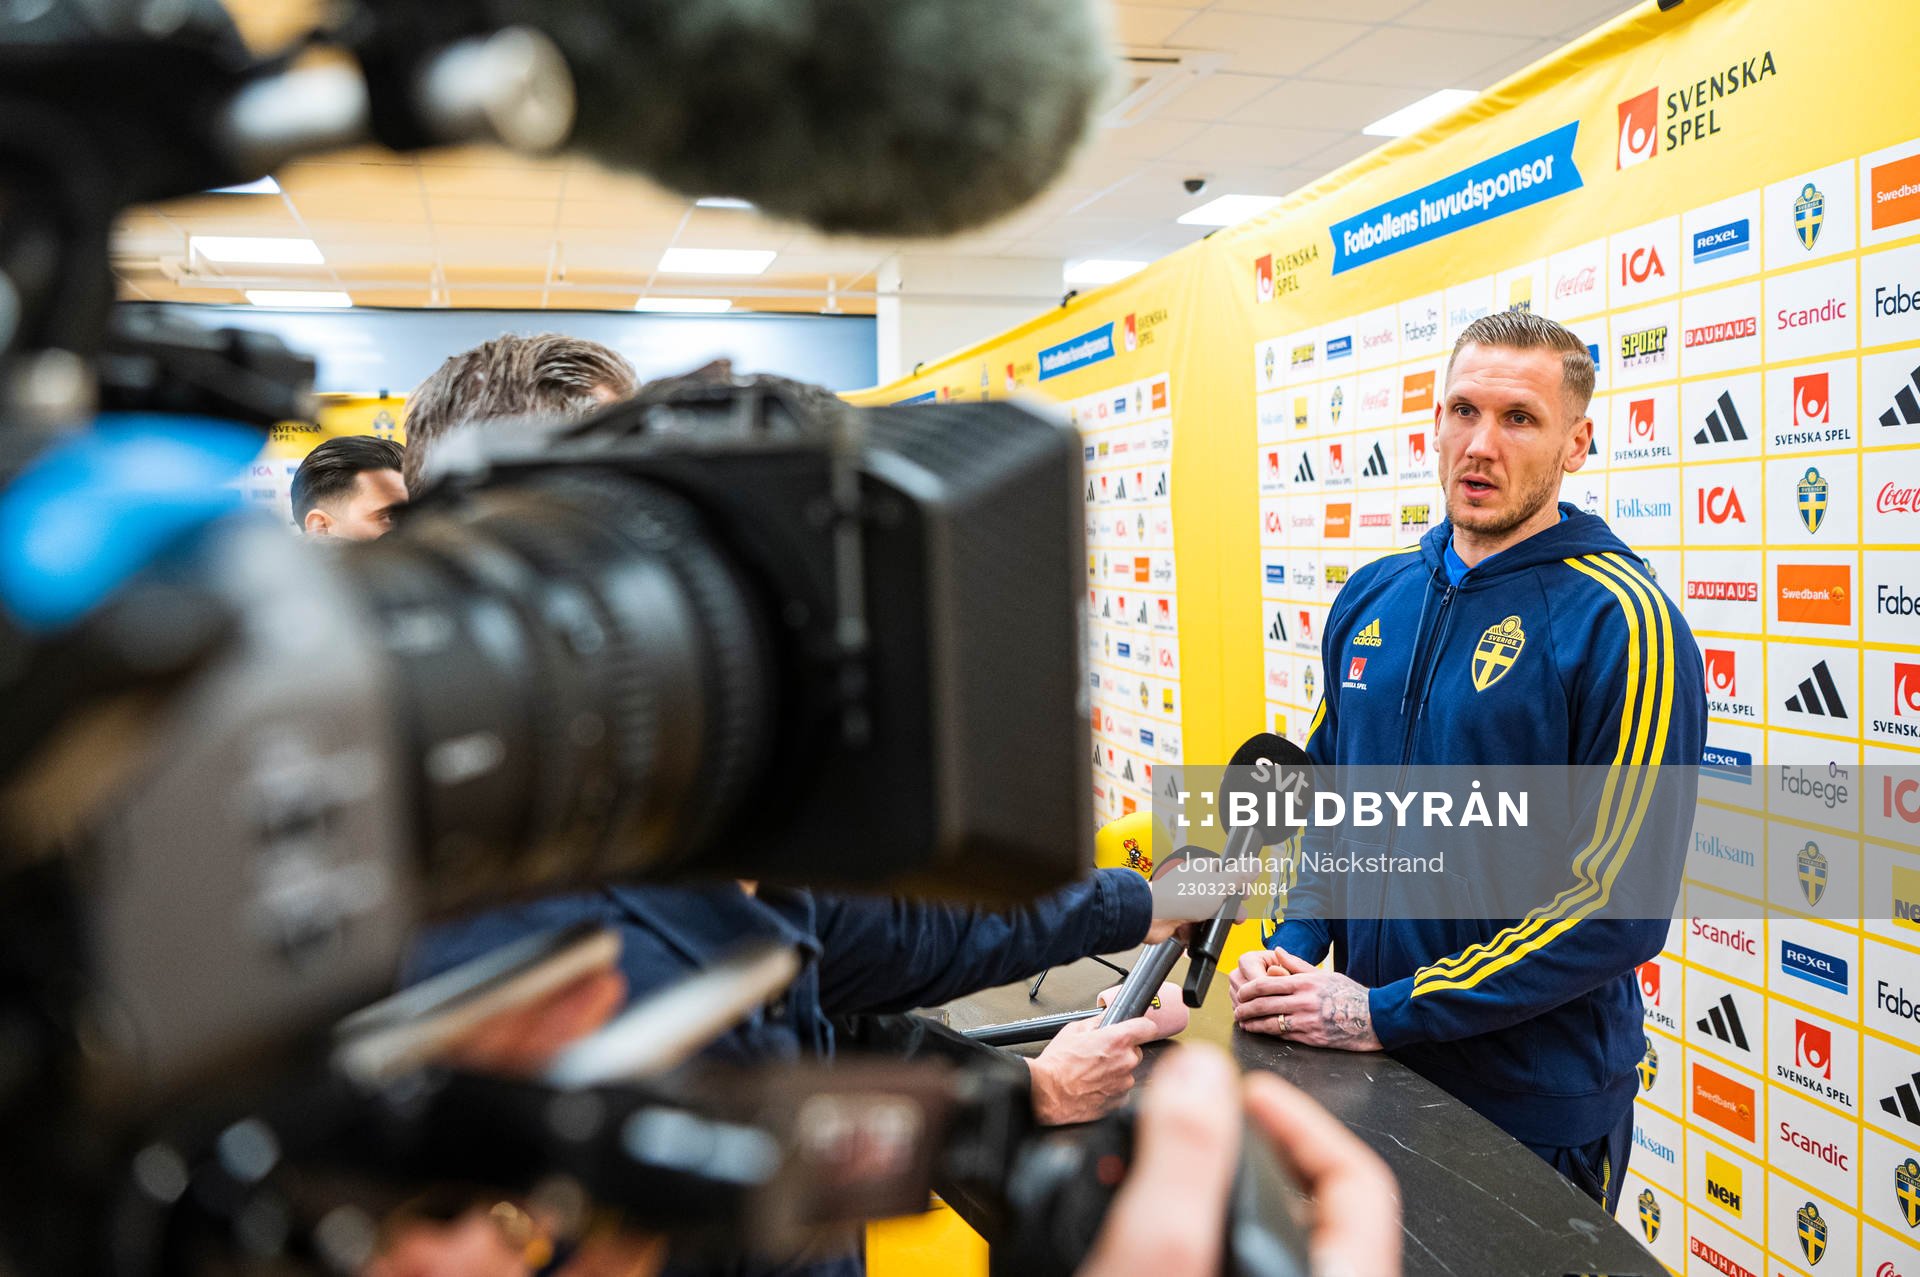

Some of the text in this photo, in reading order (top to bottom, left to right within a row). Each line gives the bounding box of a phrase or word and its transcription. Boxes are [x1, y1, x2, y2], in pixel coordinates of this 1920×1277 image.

[1667, 51, 1777, 120] SVENSKA
[1667, 109, 1721, 151] SPEL
[1344, 154, 1554, 256] Fotbollens huvudsponsor
[1622, 245, 1665, 287] ICA
[1777, 298, 1847, 330] Scandic
[1876, 284, 1920, 317] Fabe
[1405, 322, 1437, 342] Fabege
[1621, 325, 1667, 359] SPORT
[1686, 317, 1756, 347] BAUHAUS
[1623, 353, 1666, 368] BLADET
[272, 424, 321, 435] SVENSKA
[1775, 429, 1851, 446] SVENSKA SPEL
[1615, 446, 1672, 461] SVENSKA SPEL
[252, 466, 272, 476] ICA
[1616, 498, 1671, 518] Folksam
[1698, 485, 1746, 525] ICA
[1688, 581, 1758, 602] BAUHAUS
[1782, 587, 1830, 601] Swedbank
[1353, 636, 1382, 648] adidas
[1486, 634, 1517, 647] SVERIGE
[1732, 703, 1755, 717] SPEL
[1873, 719, 1920, 738] SVENSK
[1251, 757, 1309, 807] svt
[1781, 765, 1848, 808] Fabege
[1695, 832, 1755, 867] Folksam
[1692, 917, 1756, 956] Scandic
[1656, 1012, 1675, 1029] SPEL
[1697, 1086, 1737, 1112] Swedbank
[1777, 1065, 1852, 1107] SVENSKA SPEL
[1780, 1122, 1848, 1172] Scandic
